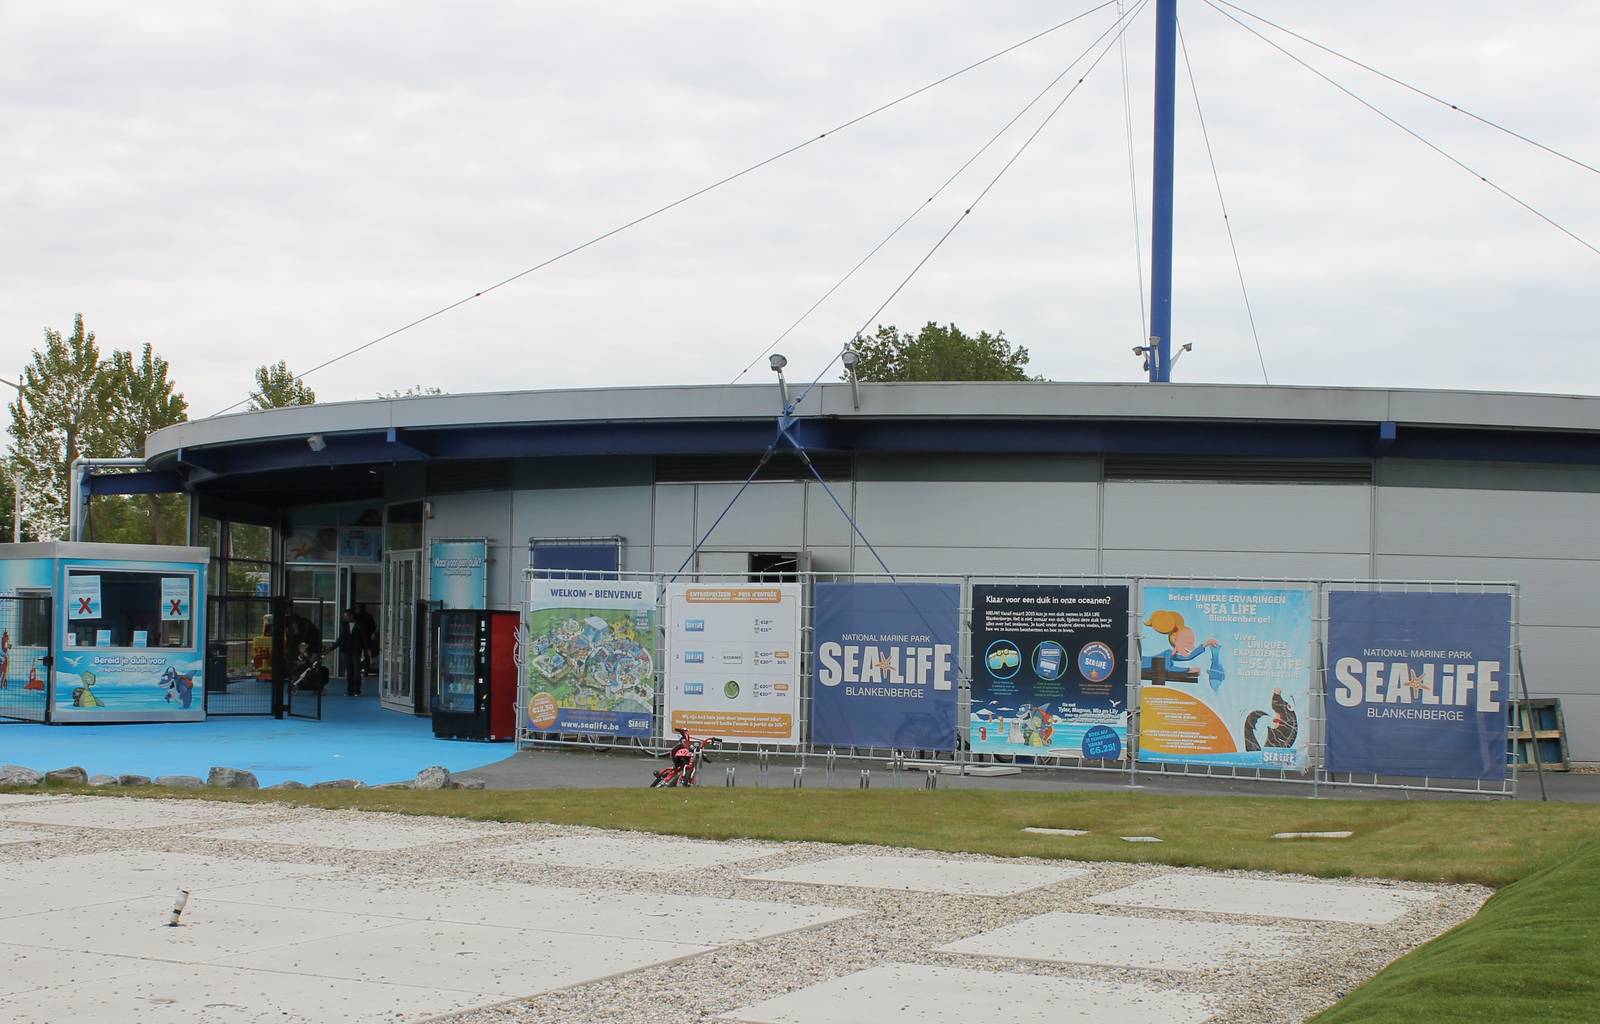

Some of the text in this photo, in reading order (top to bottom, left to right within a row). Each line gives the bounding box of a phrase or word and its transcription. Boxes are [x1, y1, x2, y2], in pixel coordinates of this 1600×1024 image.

[550, 588, 586, 598] WELKOM
[595, 590, 642, 599] BIENVENUE
[1195, 594, 1226, 603] UNIEKE
[1229, 595, 1286, 604] ERVARINGEN
[986, 595, 1004, 603] Klaar
[1036, 596, 1051, 604] duik
[1052, 596, 1059, 604] in
[1078, 596, 1111, 605] oceanen?
[1203, 604, 1227, 615] SEA
[1232, 604, 1257, 615] LIFE
[842, 634, 878, 642] NATIONAL
[910, 635, 931, 643] PARK
[1364, 649, 1473, 660] NATIONAL MARINE PARK
[94, 656, 120, 664] Bereid
[121, 657, 129, 666] je
[130, 657, 147, 665] duik
[820, 642, 882, 687] SEA
[1335, 657, 1412, 707] SEA
[846, 687, 924, 698] BLANKENBERGE
[1367, 708, 1464, 721] BLANKENBERGE
[561, 721, 620, 731] www.sealife.be
